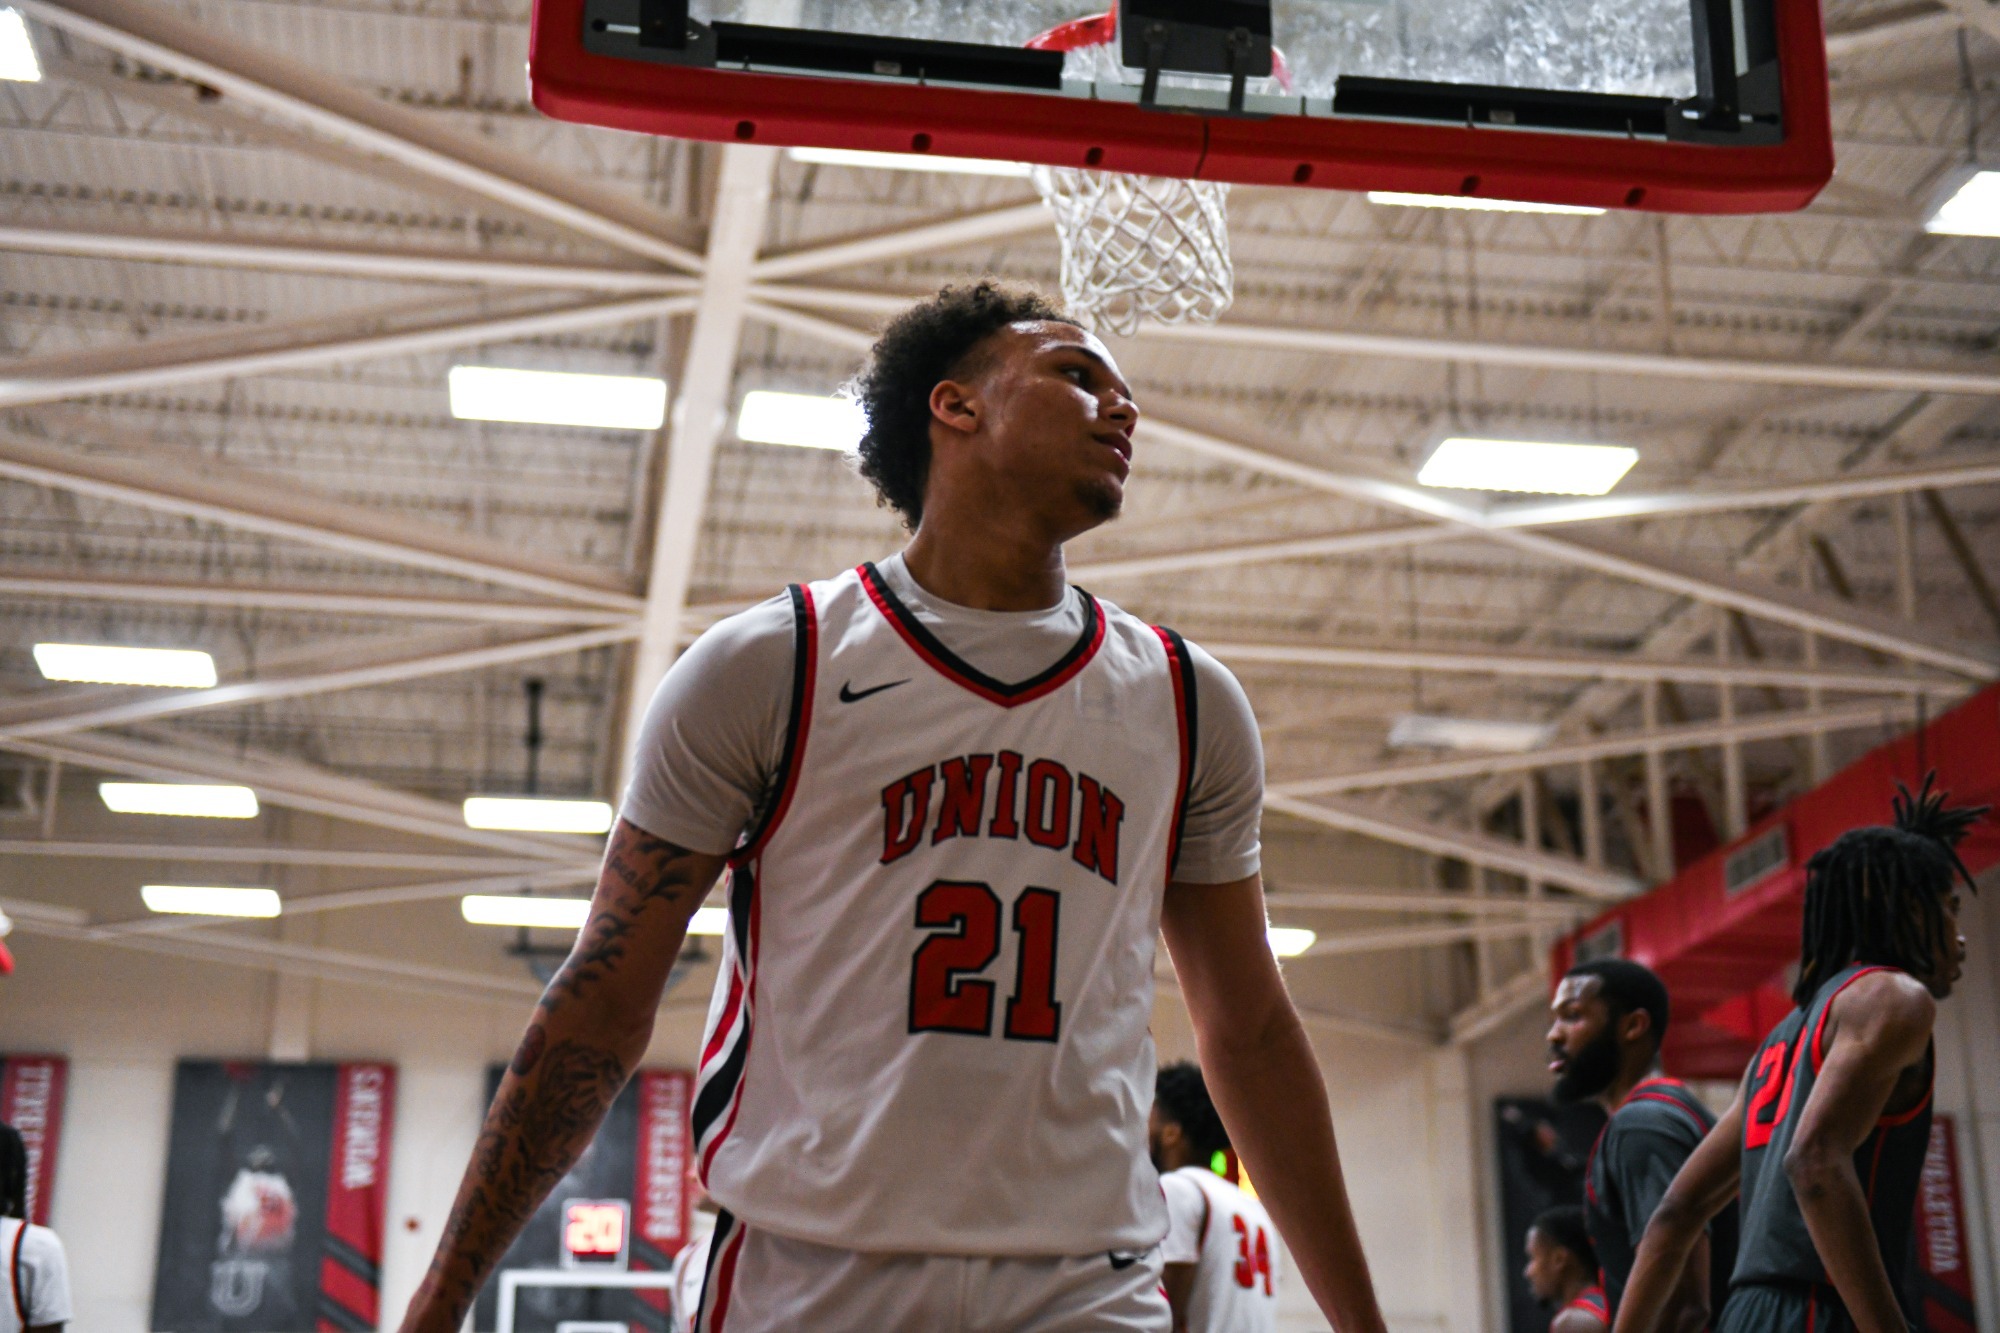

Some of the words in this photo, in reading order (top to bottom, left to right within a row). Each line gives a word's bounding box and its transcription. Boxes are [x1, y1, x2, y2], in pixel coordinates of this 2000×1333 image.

[879, 749, 1125, 886] UNION
[908, 879, 1061, 1044] 21
[566, 1204, 625, 1252] 20
[1232, 1213, 1273, 1298] 34
